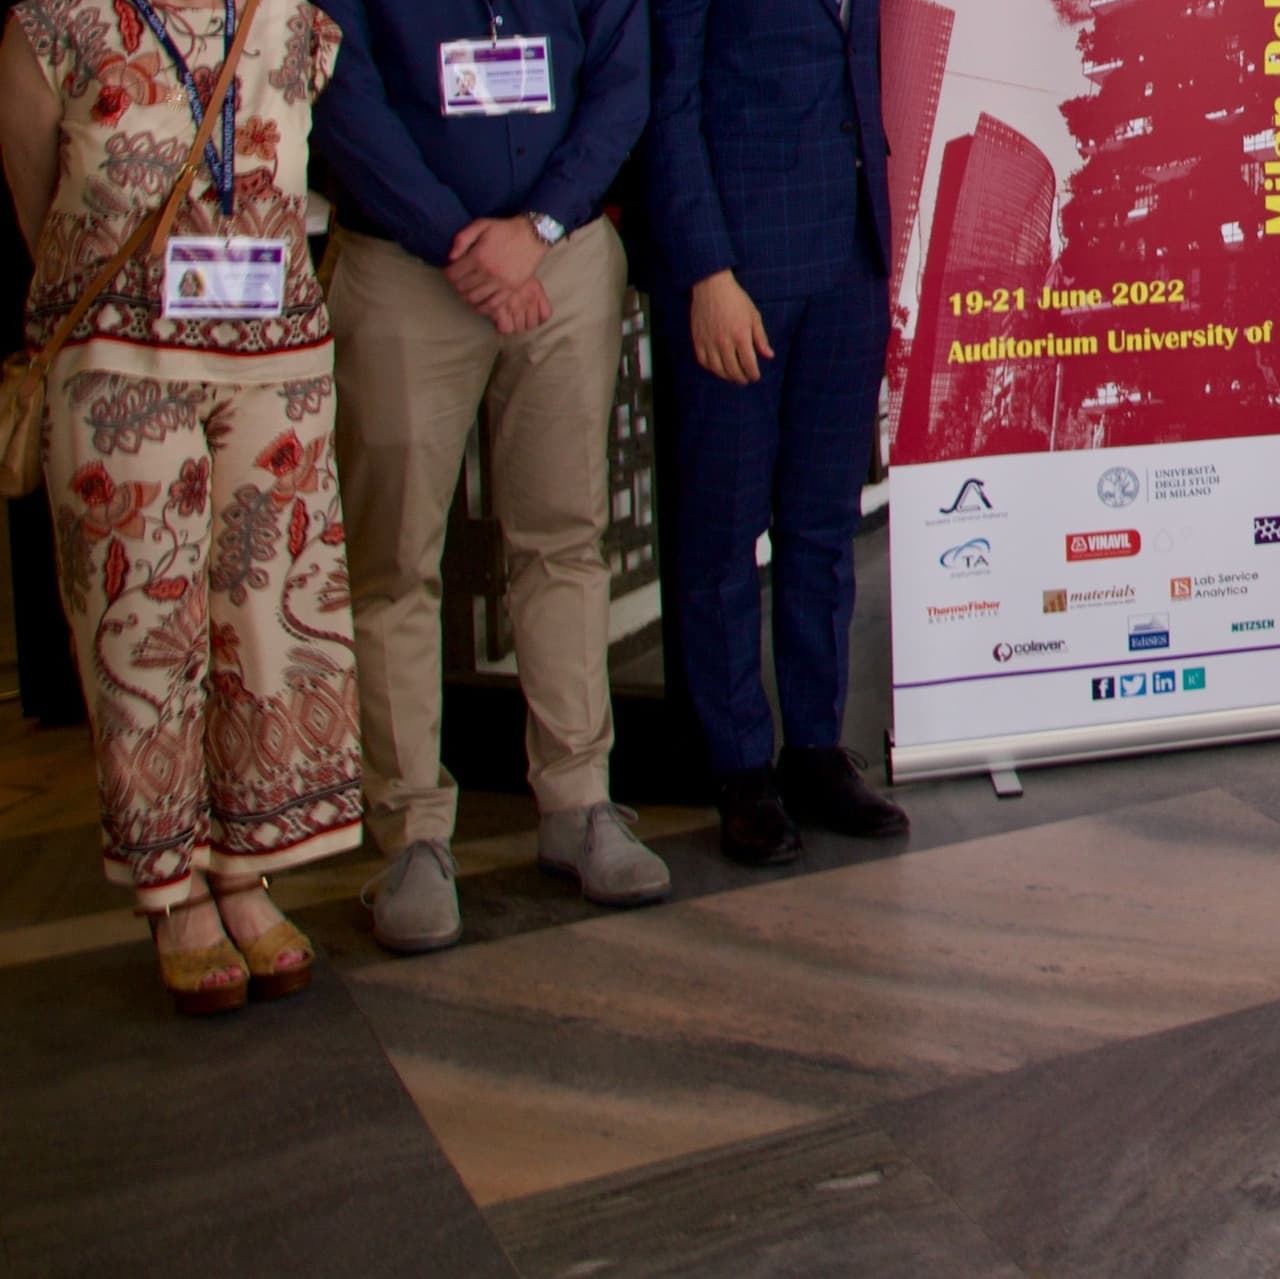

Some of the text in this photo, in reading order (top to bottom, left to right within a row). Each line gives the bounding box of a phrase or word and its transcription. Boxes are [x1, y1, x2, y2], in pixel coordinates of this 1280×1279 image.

[949, 280, 1184, 316] 19-21 June 2022
[948, 334, 1098, 363] Auditorium
[1107, 324, 1237, 351] University
[1246, 321, 1273, 342] of
[1155, 464, 1216, 478] UNIVERSITÀ
[1155, 476, 1220, 490] DEGLI STUDI
[1155, 486, 1211, 500] DI MILANO
[1088, 533, 1132, 550] VINAVIL
[962, 555, 989, 568] TA
[1194, 571, 1259, 586] Lab Service
[1070, 584, 1136, 601] materials
[1195, 586, 1248, 600] Analytica
[1231, 619, 1275, 632] NETZSCH
[1014, 639, 1066, 655] colaver
